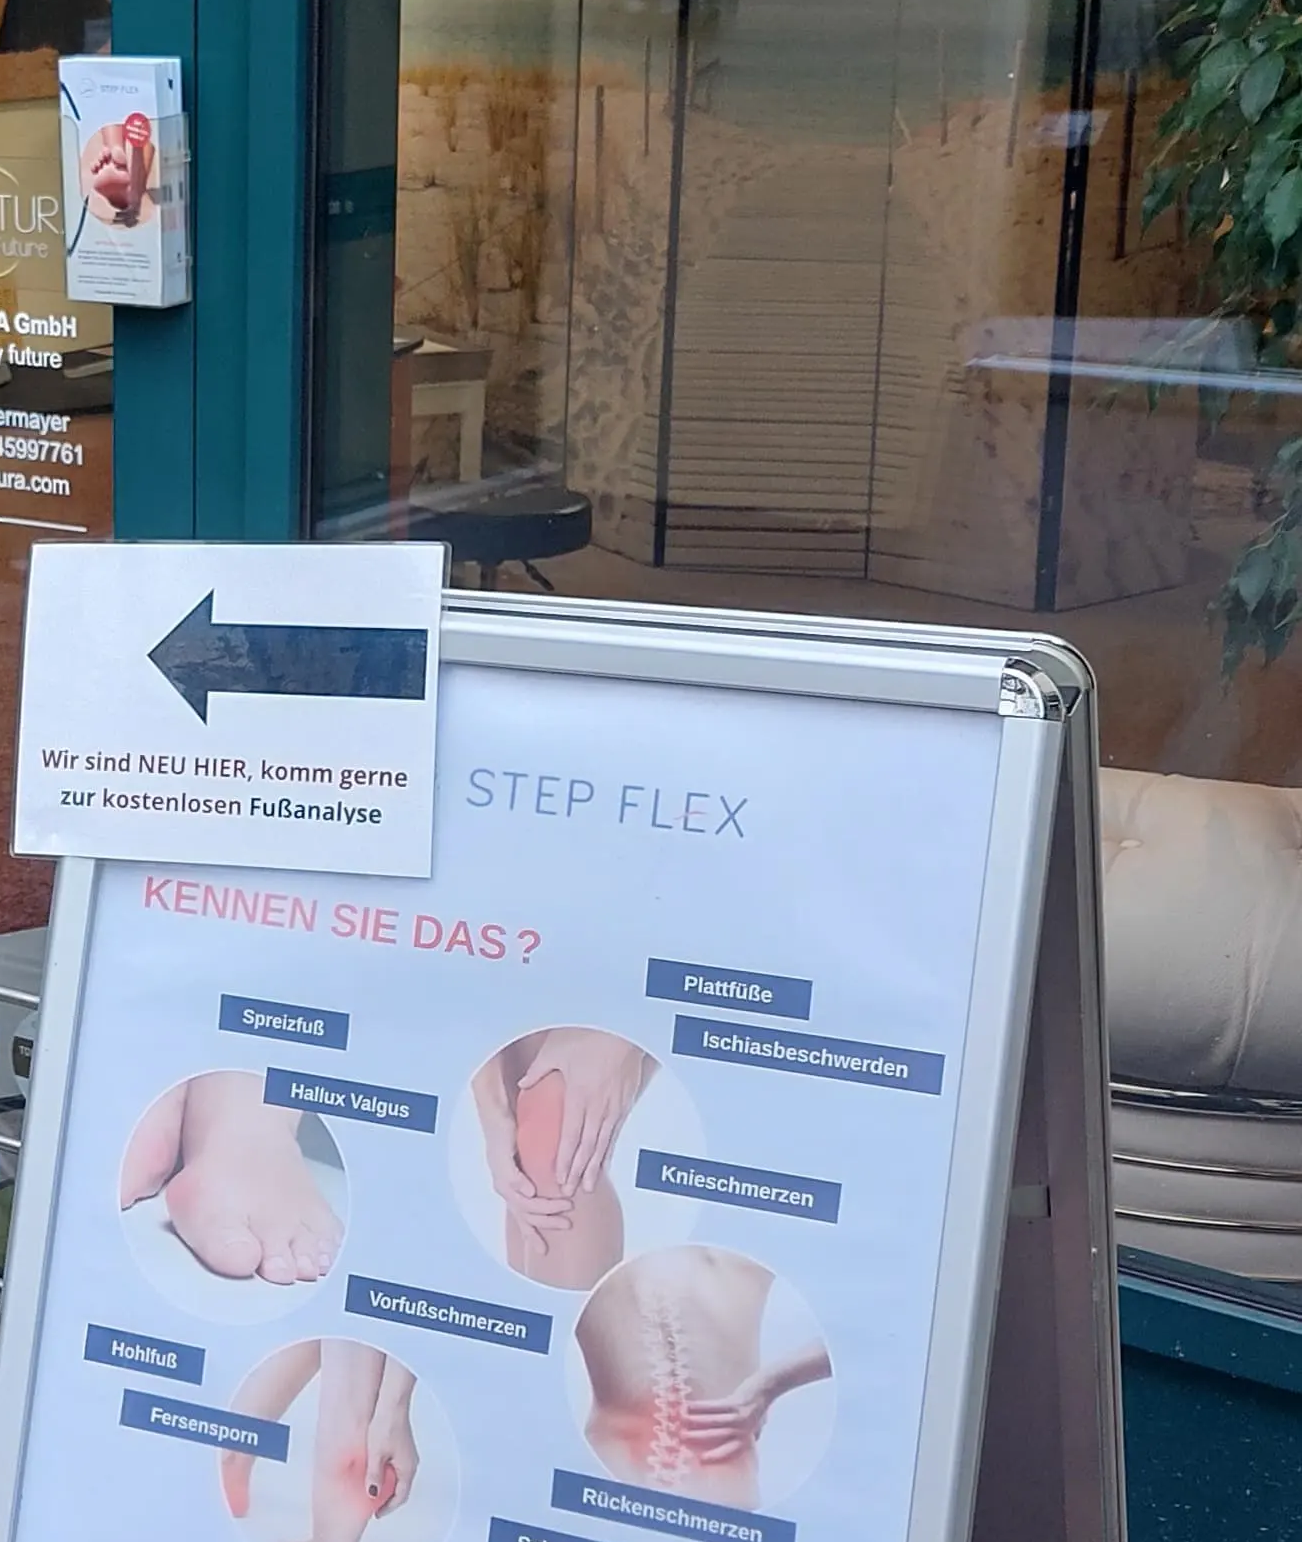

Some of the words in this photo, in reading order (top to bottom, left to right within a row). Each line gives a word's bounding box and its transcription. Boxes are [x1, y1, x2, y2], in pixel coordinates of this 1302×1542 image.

[14, 312, 77, 338] GmbH
[8, 343, 63, 369] future
[41, 748, 80, 770] Wir
[84, 751, 131, 773] sind
[138, 754, 187, 776] NEU
[193, 757, 254, 782] HIER,
[261, 760, 333, 784] komm
[339, 766, 408, 790] gerne
[60, 787, 96, 807] zur
[102, 788, 242, 817] kostenlosen
[250, 797, 383, 826] Fußanalyse
[465, 768, 595, 819] STEP
[619, 784, 749, 839] FLEX
[143, 875, 319, 934] KENNEN
[330, 902, 400, 946] SIE
[682, 972, 774, 1007] Plattfüße
[241, 1006, 327, 1041] Spreizfuß
[701, 1029, 910, 1080] Ischiasbeschwerden
[289, 1081, 347, 1111] Hallux
[349, 1090, 411, 1123] Valgus
[660, 1162, 815, 1210] Knieschmerzen
[368, 1287, 528, 1341] Vorfußschmerzen
[110, 1339, 179, 1370] Hohlfuß
[150, 1404, 260, 1450] Fersensporn
